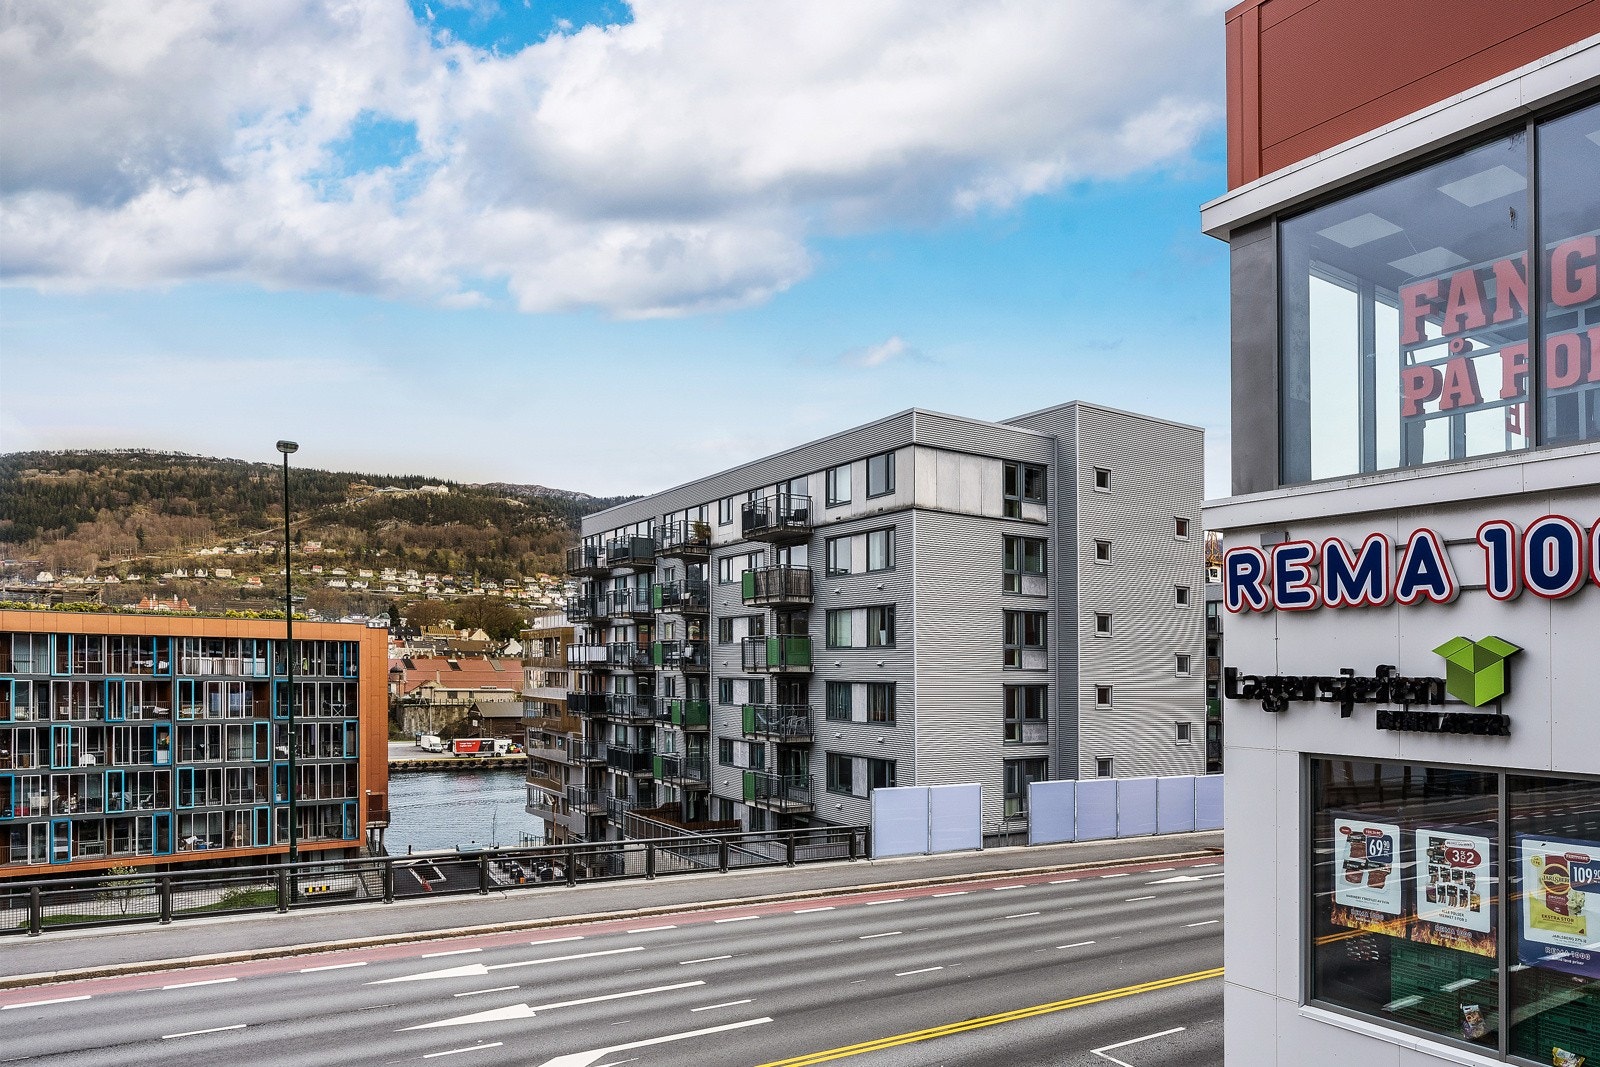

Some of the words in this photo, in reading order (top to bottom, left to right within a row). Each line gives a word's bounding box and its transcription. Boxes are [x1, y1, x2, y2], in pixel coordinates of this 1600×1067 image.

[1401, 235, 1597, 345] FANG
[1402, 337, 1483, 417] PÅ
[1224, 527, 1458, 614] REMA
[1476, 514, 1600, 601] 10
[1369, 839, 1383, 856] 69
[1452, 850, 1460, 862] 3
[1466, 852, 1475, 864] 2
[1573, 867, 1593, 884] 109
